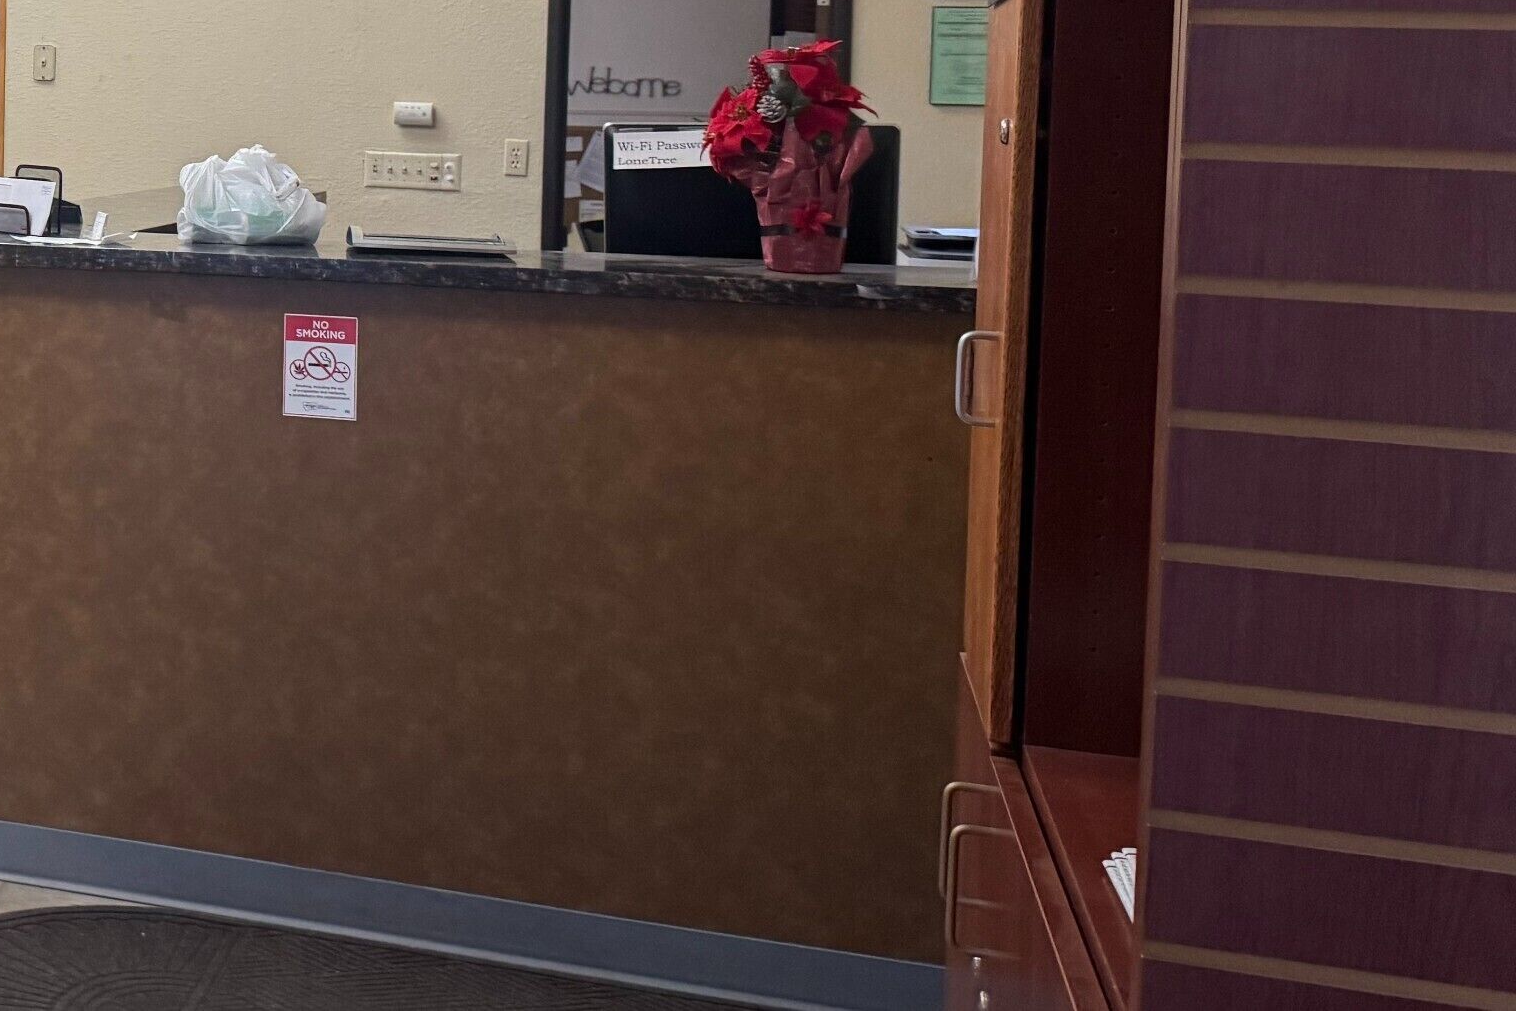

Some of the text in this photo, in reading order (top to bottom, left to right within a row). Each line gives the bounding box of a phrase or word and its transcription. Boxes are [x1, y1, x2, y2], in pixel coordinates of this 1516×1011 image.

[617, 141, 652, 152] Wi-Fi
[618, 156, 677, 166] LoneTree
[312, 320, 329, 330] NO
[296, 329, 346, 340] SMOKING
